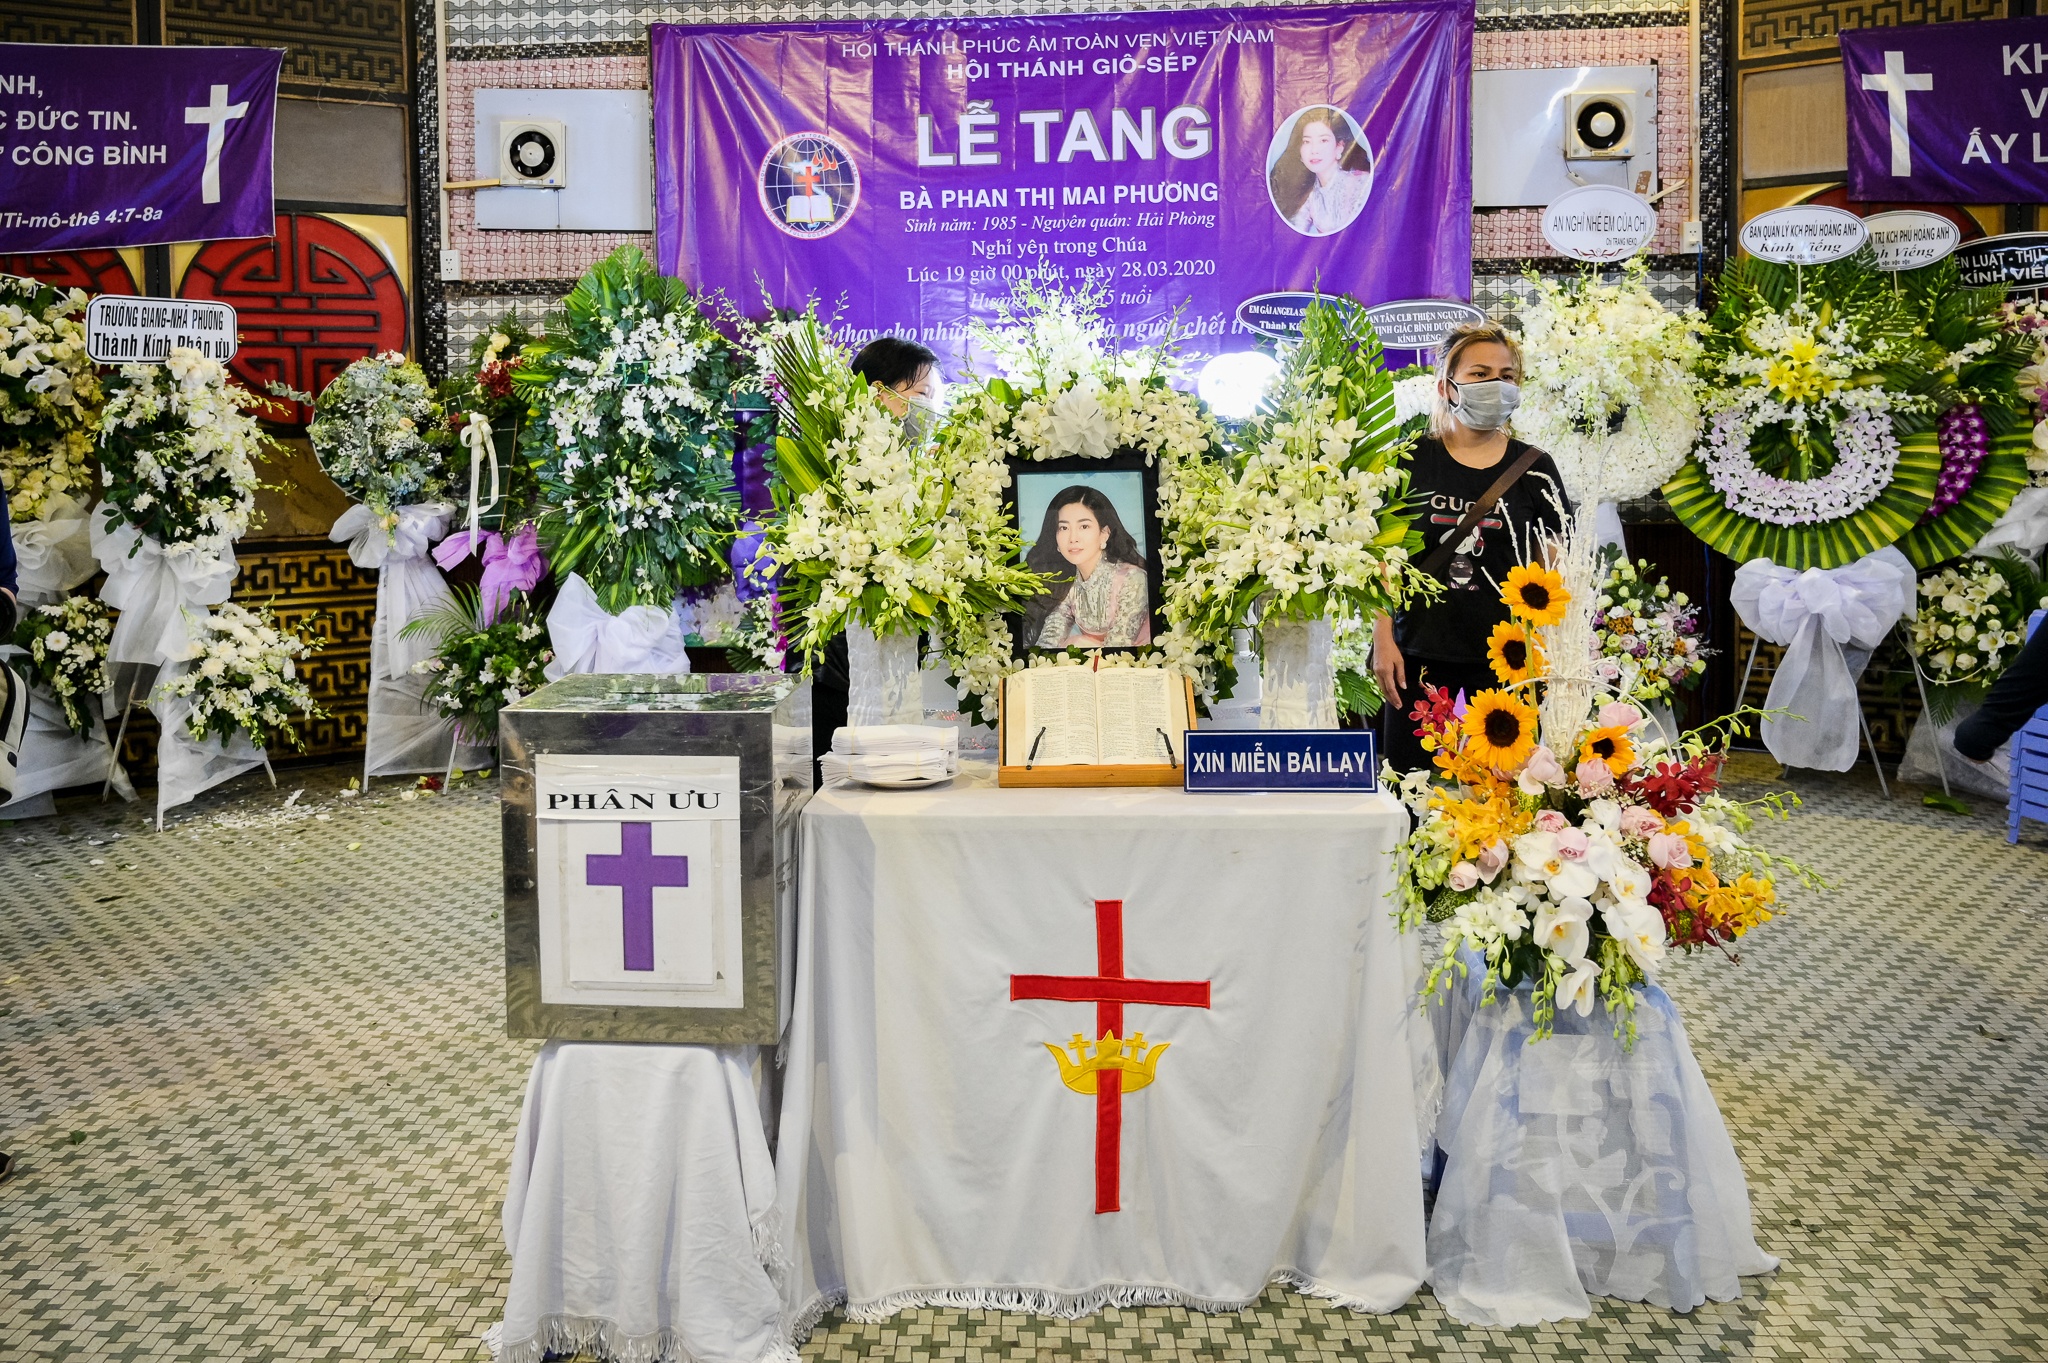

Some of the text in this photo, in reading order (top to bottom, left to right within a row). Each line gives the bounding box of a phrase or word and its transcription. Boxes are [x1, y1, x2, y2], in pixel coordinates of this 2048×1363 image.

[842, 28, 1275, 59] HỘI THÁNH PHÚC ÂM TOÀN VẸN VIỆT NAM
[947, 51, 1198, 82] HỘI THÁNH GIÔ-SÉP
[16, 105, 79, 130] ĐỨC
[88, 110, 137, 130] TIN.
[915, 99, 1212, 166] LỄ TANG
[12, 141, 167, 165] CÔNG BÌNH
[1961, 127, 2019, 164] ẤY
[900, 181, 1219, 210] BÀ PHAN THỊ MAI PHƯƠNG
[105, 206, 163, 223] 4:7-8a
[905, 218, 936, 233] Sinh
[940, 219, 977, 232] năm:
[982, 216, 1016, 231] 1985
[1031, 216, 1087, 233] Nguyên
[1089, 214, 1131, 231] quán:
[1136, 211, 1164, 227] Hải
[1167, 211, 1216, 229] Phòng
[1553, 215, 1564, 232] AN
[1586, 211, 1602, 232] NHÉ
[1604, 215, 1615, 232] EM
[1616, 211, 1633, 232] CỦA
[1749, 219, 1857, 240] BAN QUẢN LÝ KCH PHÚ HOÀNG ANH
[1886, 230, 1899, 243] KCH
[1899, 225, 1912, 242] PHÚ
[1913, 224, 1935, 241] HOÀNG
[1936, 226, 1950, 240] ANH
[971, 236, 1147, 259] Nghỉ yên trong Chúa
[1760, 239, 1842, 253] Kính iếng
[1895, 244, 1935, 258] Viếng
[1972, 251, 2005, 269] LUẬT
[907, 266, 940, 282] Lúc
[946, 266, 965, 282] 19
[970, 265, 997, 285] giờ
[1001, 264, 1022, 281] 00
[1075, 261, 1116, 281] ngày
[1121, 259, 1216, 278] 28.03.2020
[1960, 264, 2048, 284] KÍNH VIẾ
[1120, 285, 1153, 305] tuổi
[100, 301, 138, 327] TRƯỜNG
[192, 307, 223, 331] PHƯƠNG
[1249, 305, 1260, 314] EM
[1260, 304, 1272, 314] GÁI
[1273, 306, 1299, 316] ANGELA
[1397, 314, 1412, 323] CLB
[1413, 312, 1435, 323] THIỆN
[1436, 309, 1469, 321] NGUYỆN
[1259, 320, 1287, 330] Thành
[1394, 322, 1413, 334] GIÁC
[1414, 321, 1433, 333] BÌNH
[94, 333, 138, 357] Thành
[143, 334, 171, 357] Kính
[1397, 333, 1417, 344] KÍNH
[1430, 494, 1500, 514] GUCI
[1193, 742, 1367, 777] XIN MIỄN BÁI LẠY
[547, 789, 721, 810] PHÂN ƯU
